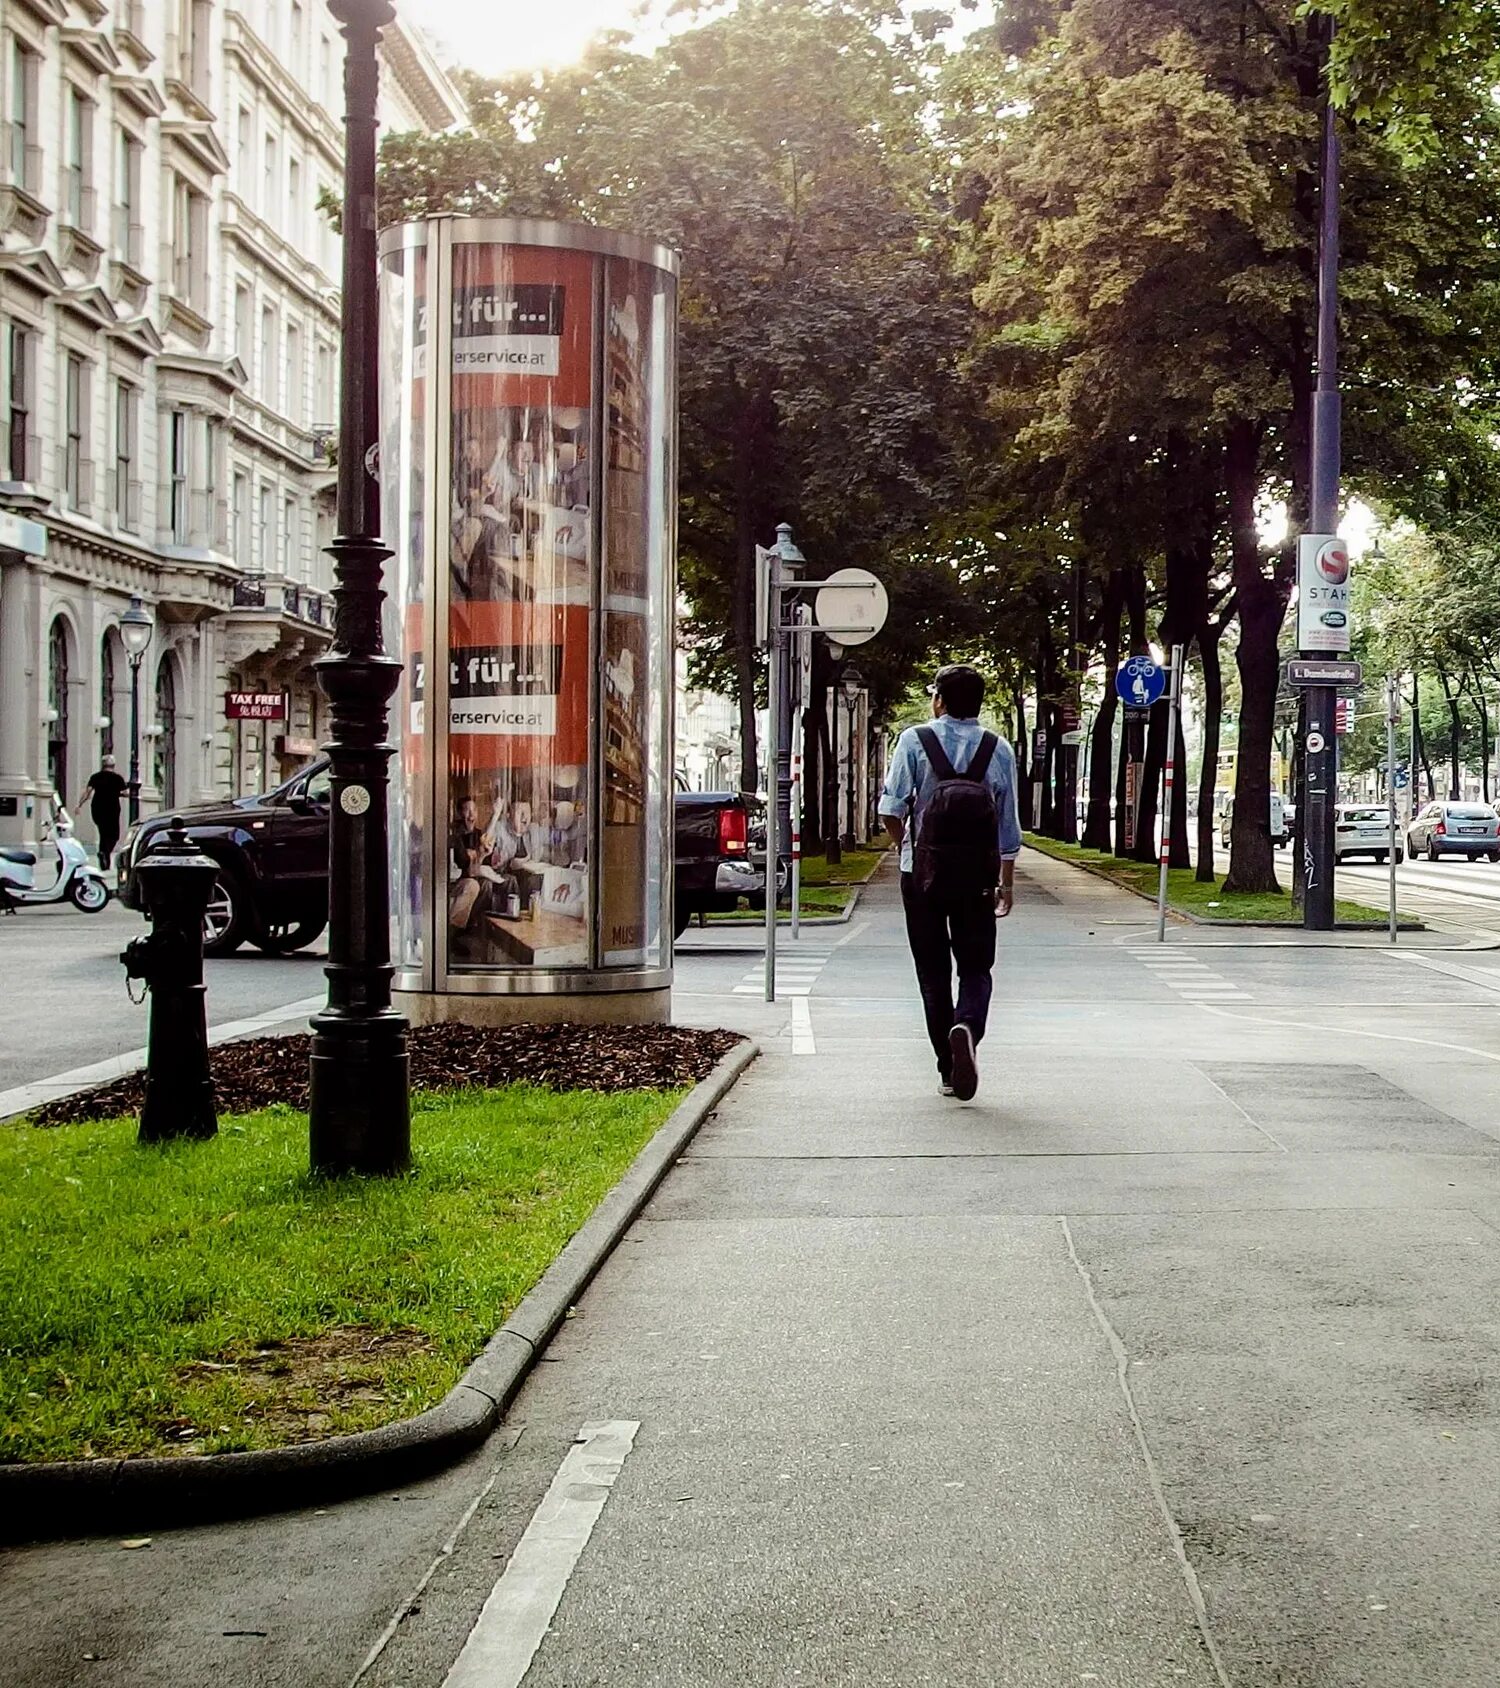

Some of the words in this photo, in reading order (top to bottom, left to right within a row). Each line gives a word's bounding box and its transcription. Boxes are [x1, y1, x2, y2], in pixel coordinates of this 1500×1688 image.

[470, 296, 547, 324] für...
[454, 349, 546, 366] erservice.at
[416, 661, 460, 689] zt
[467, 656, 544, 684] für...
[231, 694, 253, 705] TAX
[254, 694, 281, 705] FREE
[450, 709, 542, 727] erservice.at
